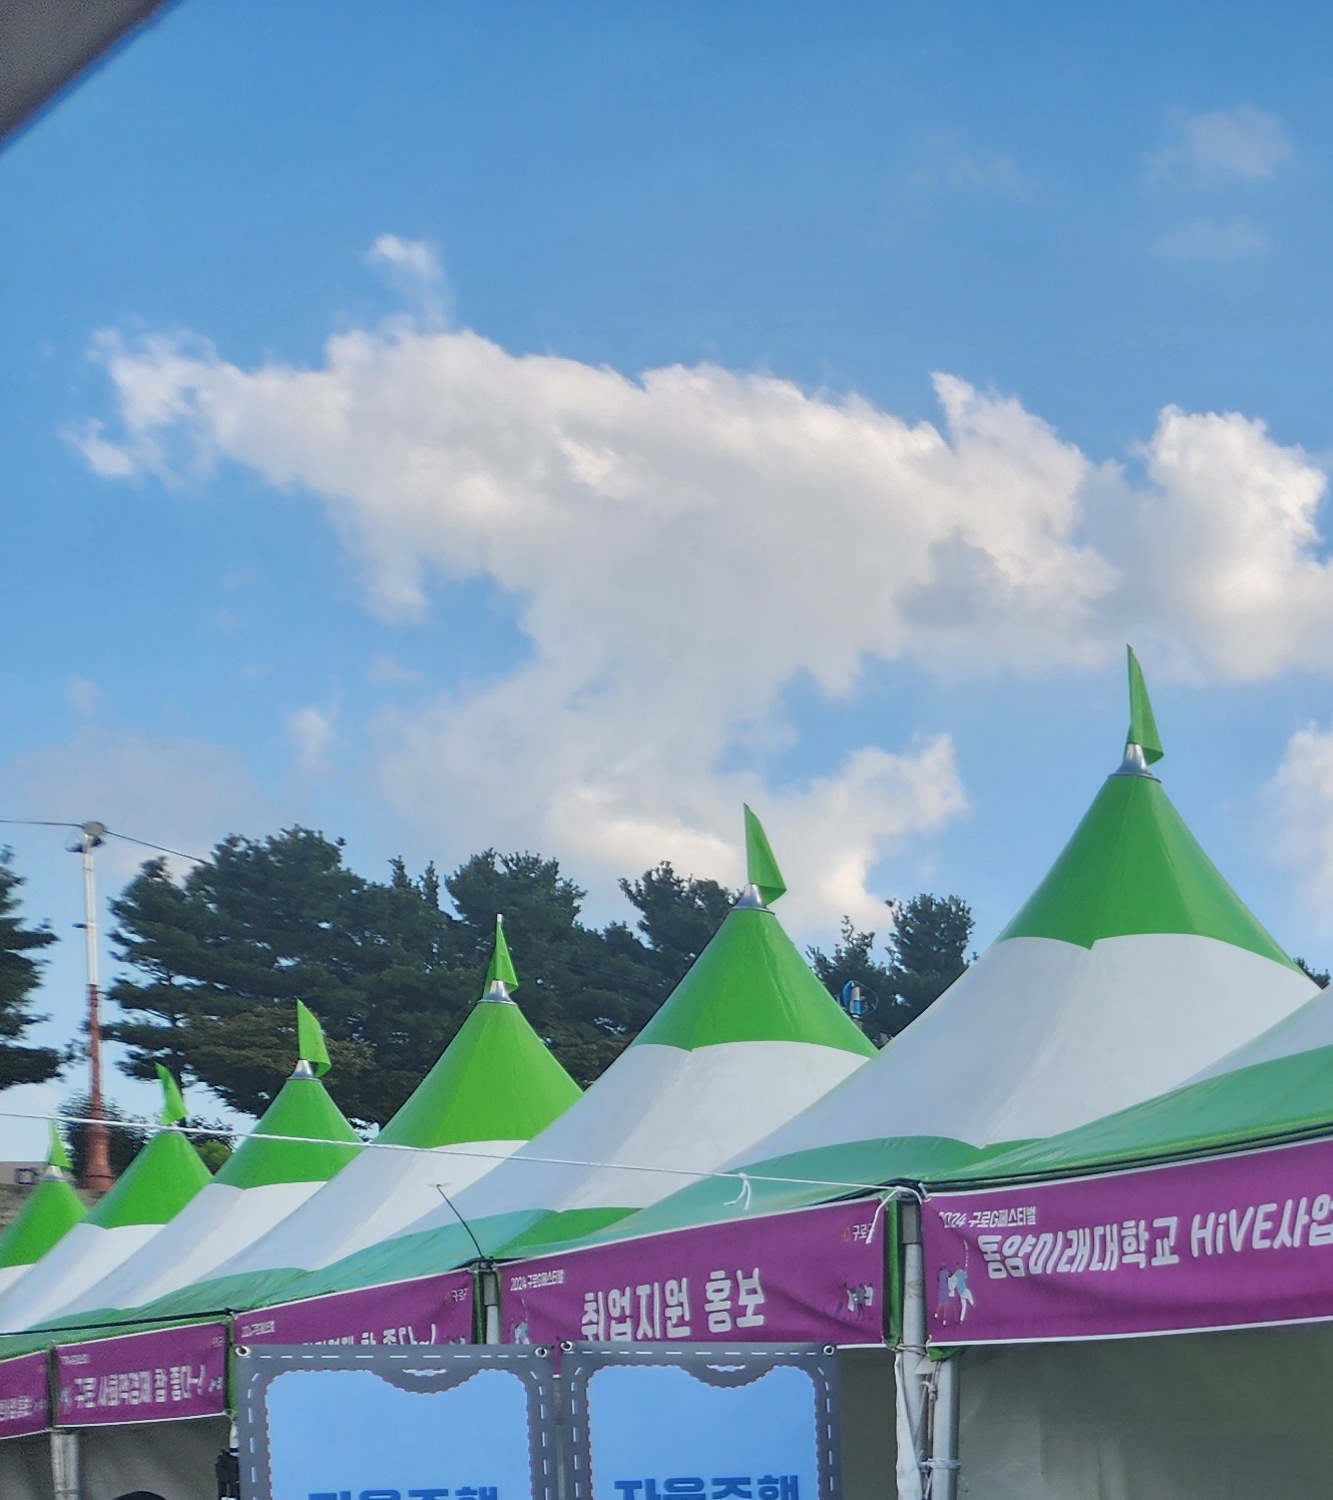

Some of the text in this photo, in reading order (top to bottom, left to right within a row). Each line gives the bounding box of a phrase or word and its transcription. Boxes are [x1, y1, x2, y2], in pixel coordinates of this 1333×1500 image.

[968, 1206, 1037, 1229] 구로G페스티벌
[977, 1216, 1179, 1279] 동양미래대학교
[510, 1276, 526, 1292] 2024
[581, 1267, 766, 1342] 취업지원 홍보
